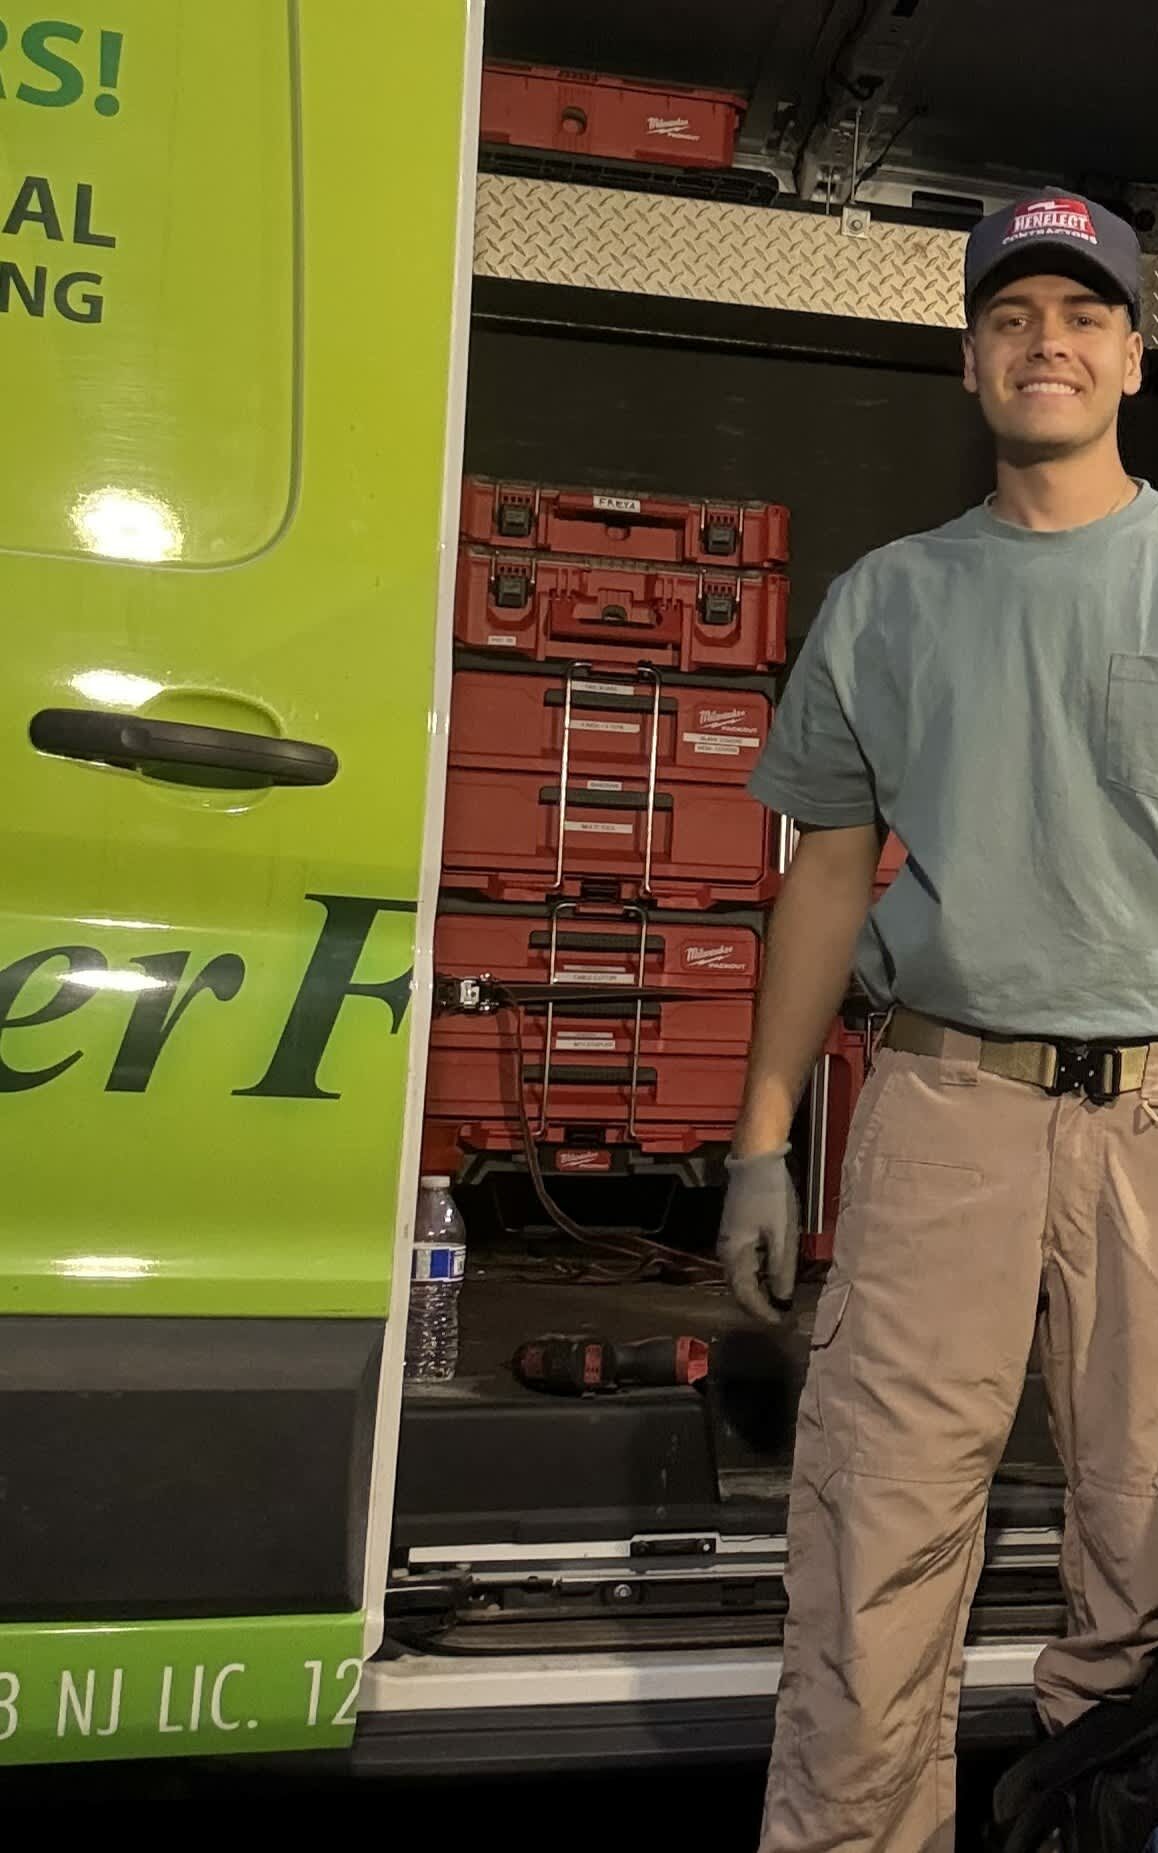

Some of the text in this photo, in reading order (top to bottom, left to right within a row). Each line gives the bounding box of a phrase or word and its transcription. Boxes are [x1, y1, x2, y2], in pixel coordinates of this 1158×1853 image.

[0, 19, 124, 118] S!
[2, 175, 117, 249] AL
[0, 261, 104, 324] NG
[56, 1668, 124, 1737] NJ
[158, 1663, 259, 1733] LIC.
